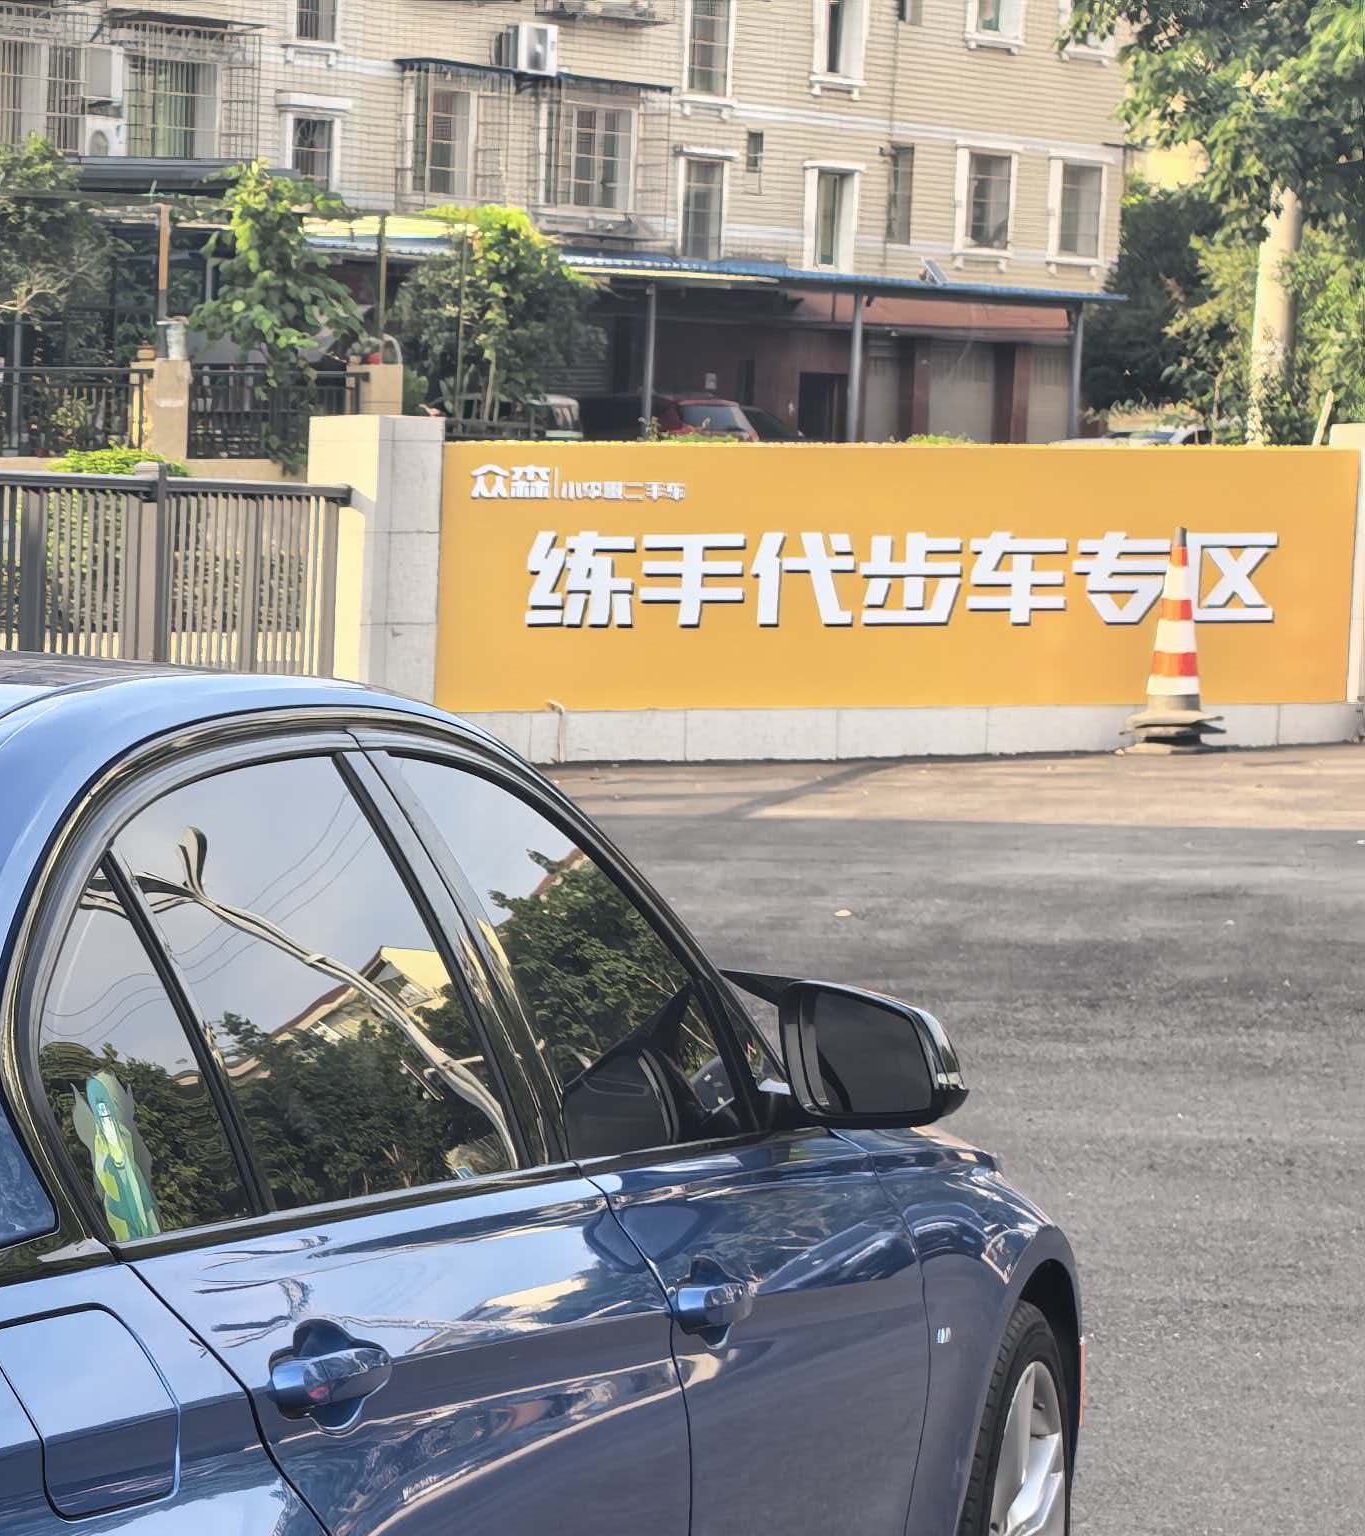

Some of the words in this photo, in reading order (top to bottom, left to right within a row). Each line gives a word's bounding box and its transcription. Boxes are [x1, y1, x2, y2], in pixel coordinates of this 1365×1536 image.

[525, 530, 1279, 629] 练手代步车专区
